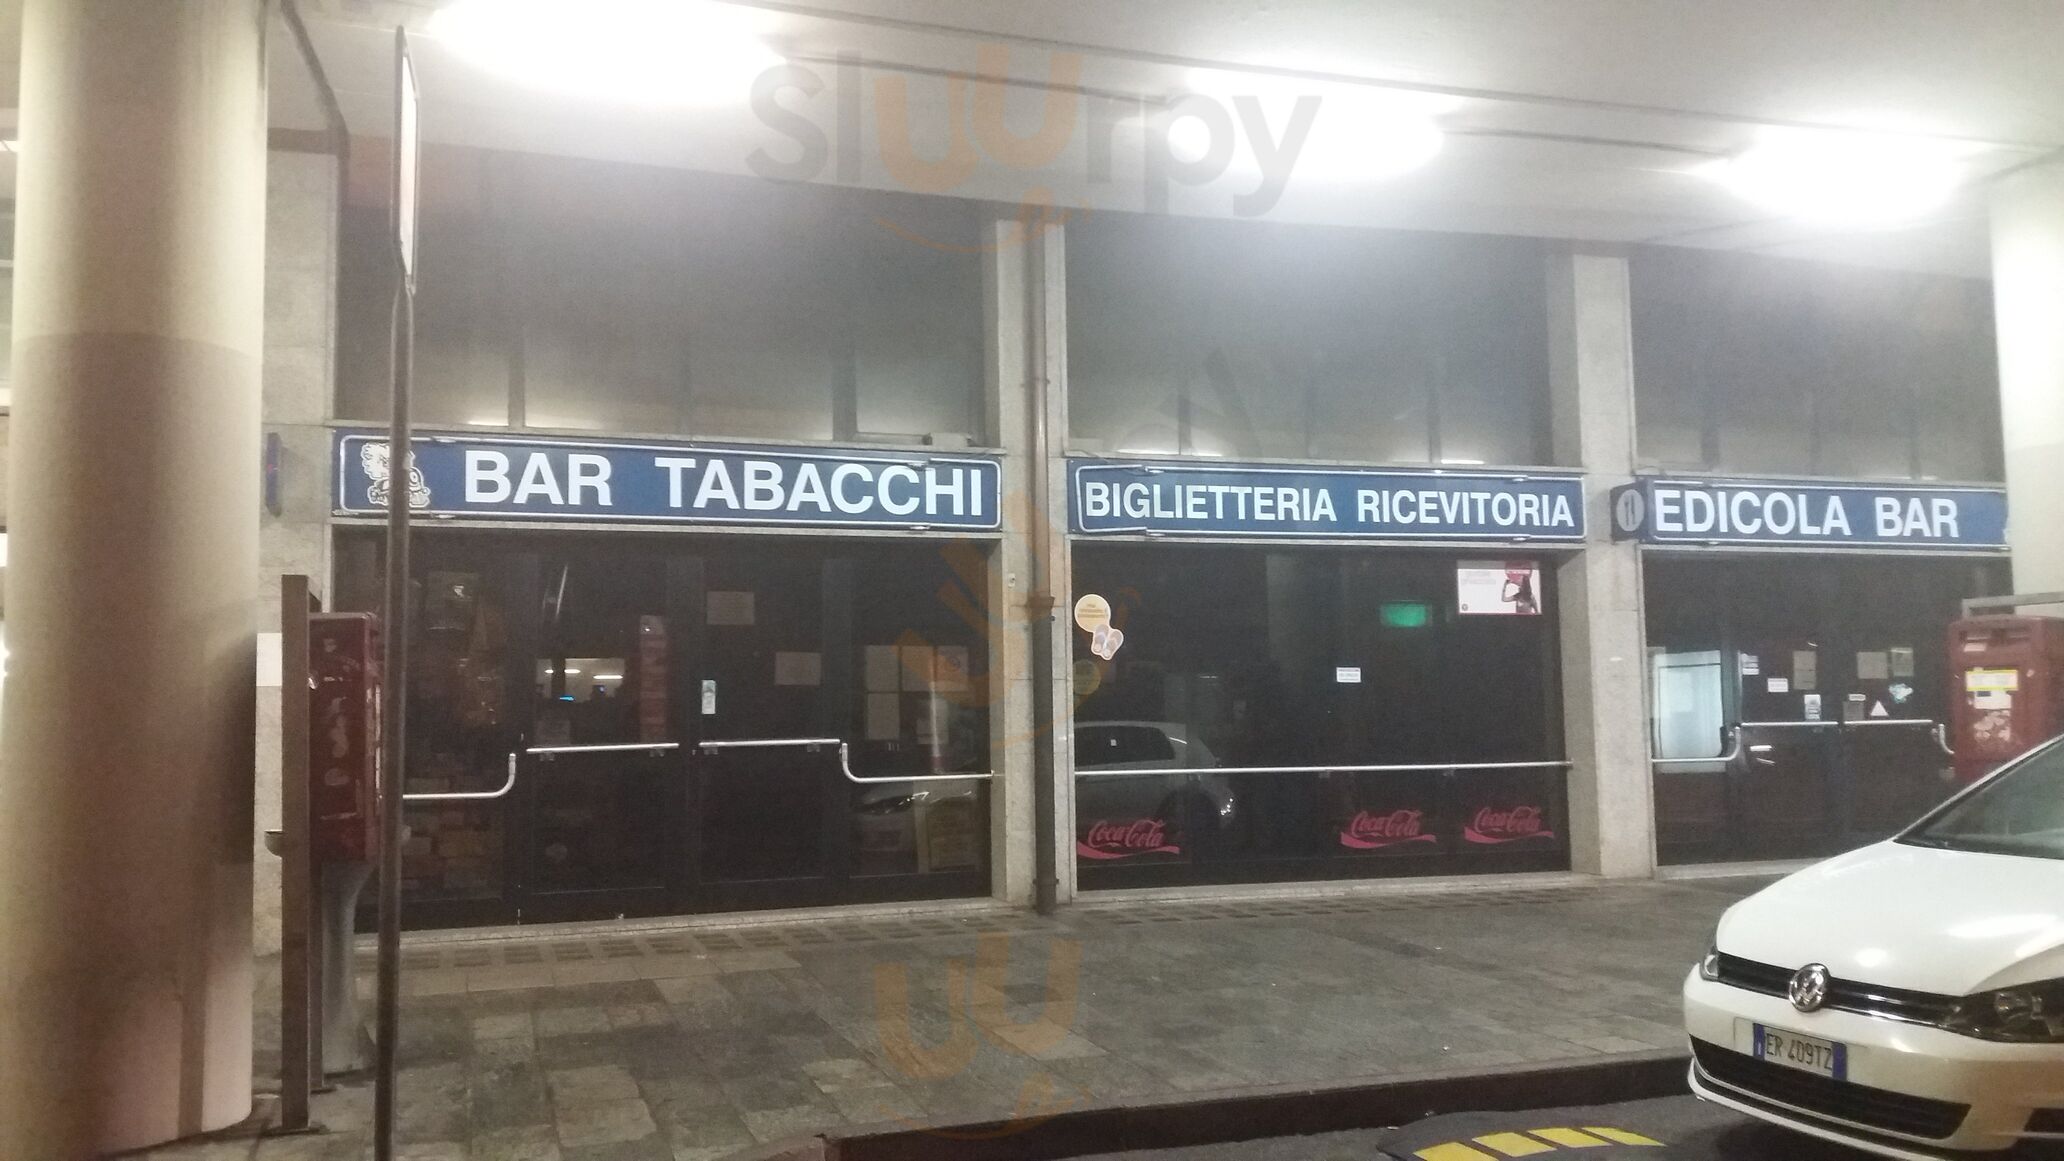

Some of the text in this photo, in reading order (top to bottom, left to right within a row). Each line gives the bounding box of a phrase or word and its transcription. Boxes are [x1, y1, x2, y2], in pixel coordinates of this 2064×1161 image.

[465, 449, 983, 517] BAR TABACCHI
[1085, 481, 1575, 528] BIGLIETTERIA RICEVITORIA
[1654, 489, 1960, 538] EDICOLA BAR
[1766, 1032, 1783, 1057] ER
